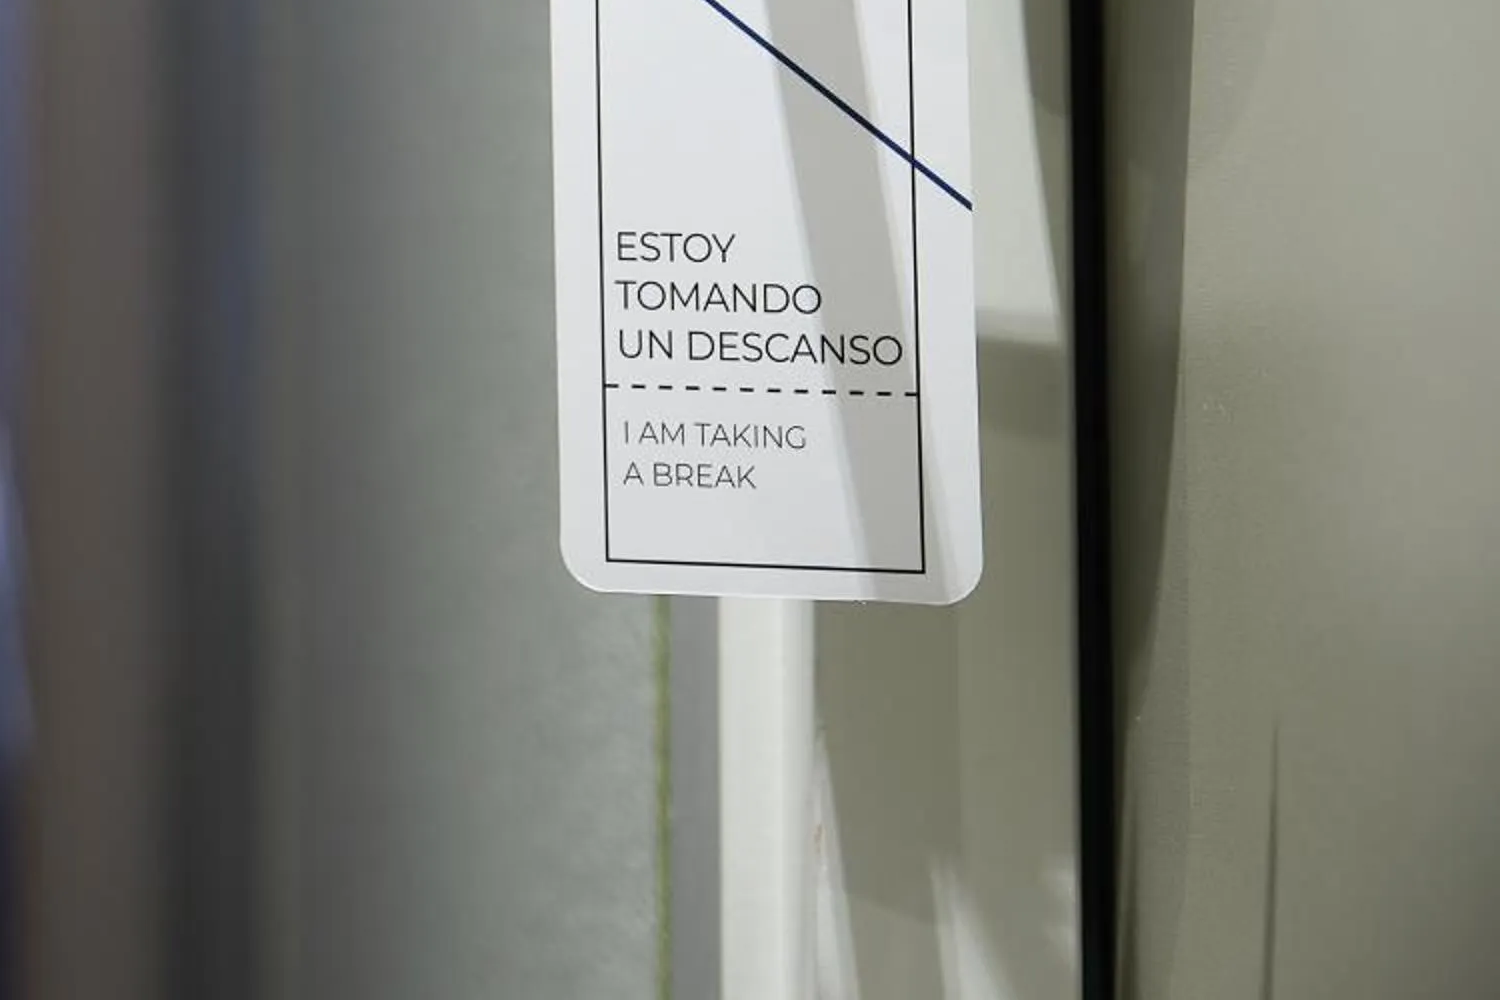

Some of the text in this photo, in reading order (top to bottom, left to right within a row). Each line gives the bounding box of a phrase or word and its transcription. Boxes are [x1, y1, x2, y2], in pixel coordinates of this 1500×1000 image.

[616, 231, 736, 263] ESTOY
[614, 280, 822, 314] TOMANDO
[618, 329, 903, 366] UN DESCANSO
[623, 420, 807, 450] I AM TAKING
[622, 461, 757, 490] A BREAK
